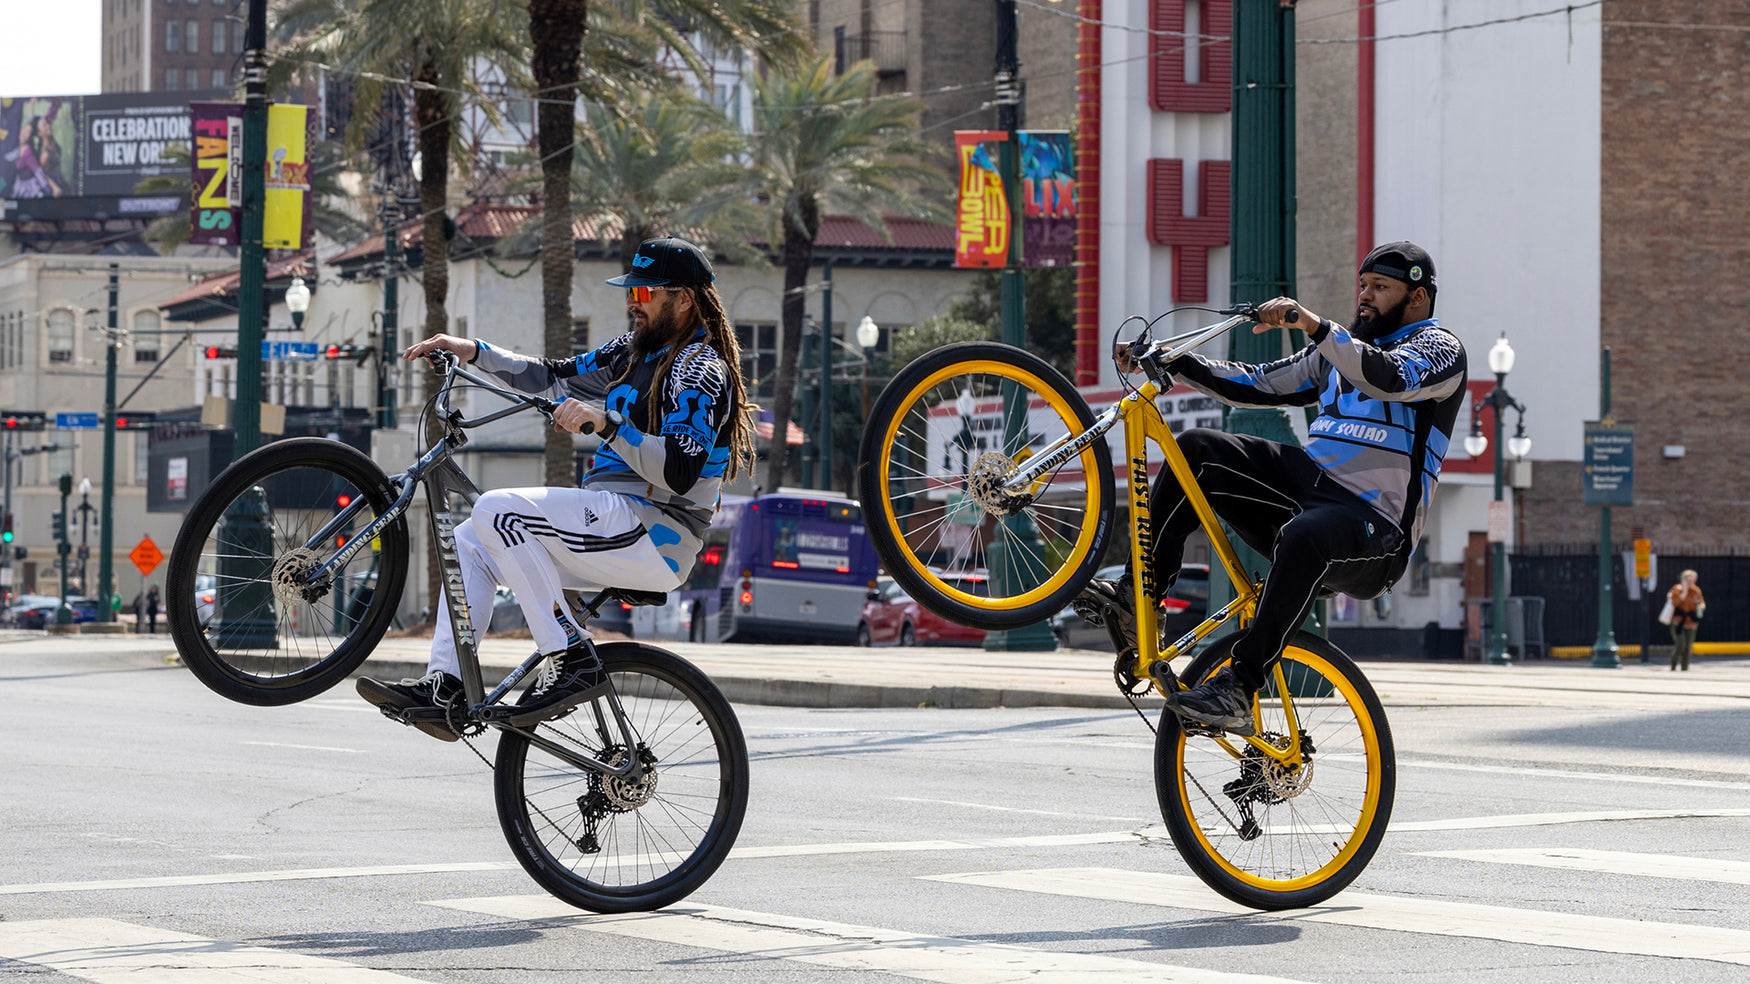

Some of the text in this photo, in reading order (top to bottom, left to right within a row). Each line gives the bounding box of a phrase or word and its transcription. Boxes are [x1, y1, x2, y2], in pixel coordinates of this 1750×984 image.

[103, 142, 137, 165] NEW
[196, 120, 232, 230] FANS
[231, 125, 240, 201] WELCOME
[672, 424, 690, 433] RIDE
[1335, 422, 1388, 443] SQUAD
[326, 506, 400, 574] LANDING GEAR
